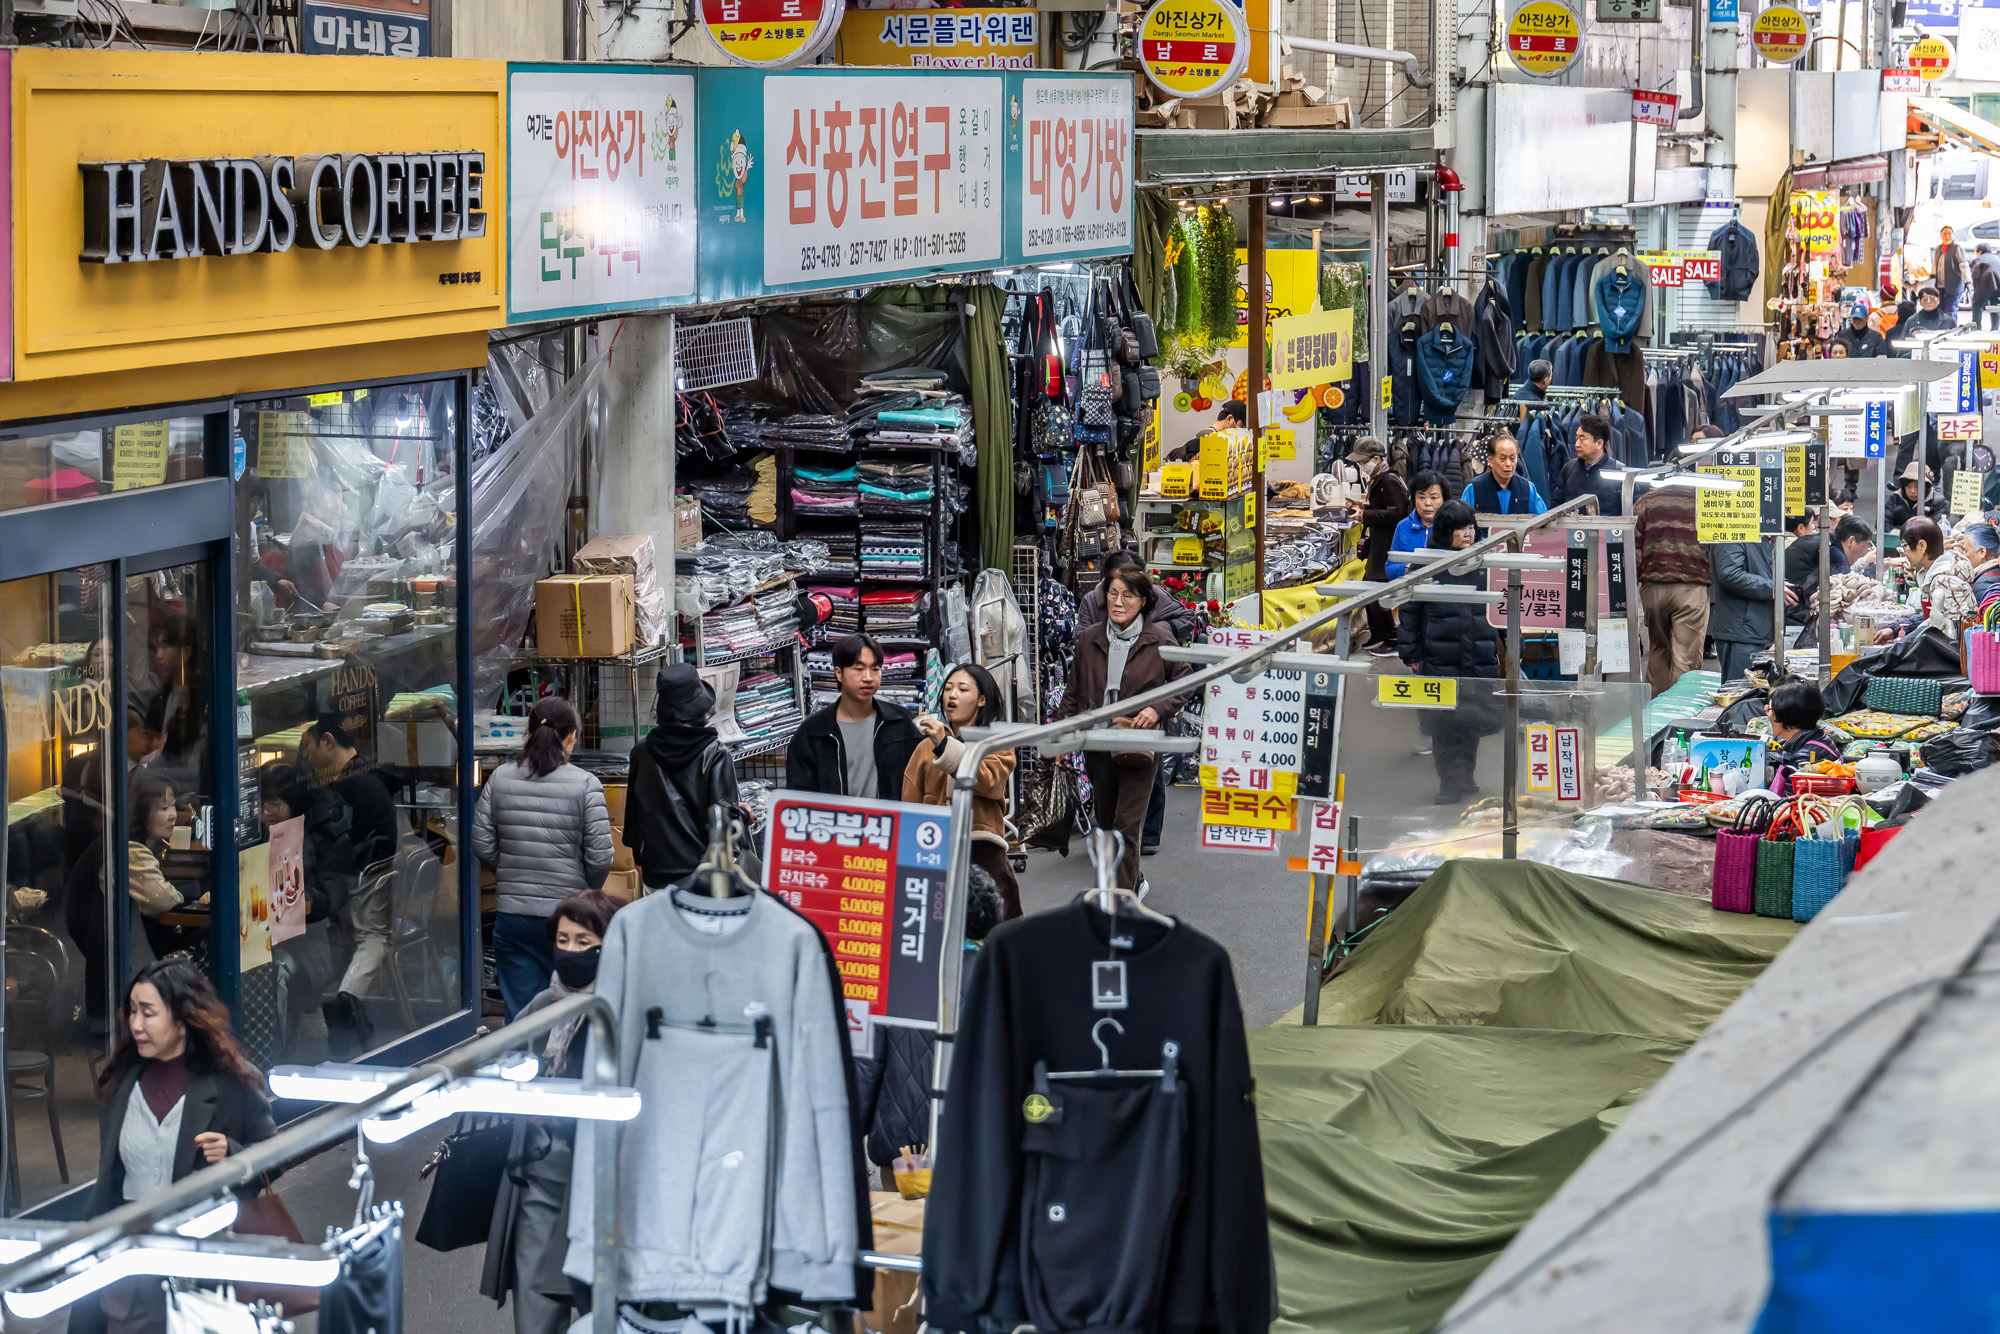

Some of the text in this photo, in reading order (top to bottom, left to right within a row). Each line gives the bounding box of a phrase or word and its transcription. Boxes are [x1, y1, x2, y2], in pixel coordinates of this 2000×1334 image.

[1155, 11, 1223, 30] 아진상가
[1519, 13, 1570, 28] 아진상가
[1761, 16, 1800, 27] 아진상가
[314, 15, 420, 57] 마네킹
[764, 28, 805, 39] 소방통로
[912, 54, 1034, 67] Flower land
[1188, 68, 1220, 76] 소방통로
[527, 110, 645, 182] 여기는 아진상가
[787, 101, 951, 229] 삼흥진열구
[1030, 117, 1127, 220] 대영가방
[80, 156, 295, 264] HANDS
[298, 150, 487, 250] COFFEE
[801, 244, 841, 271] 253-4793
[849, 239, 888, 266] 257-7427
[1652, 267, 1681, 285] SALE
[1685, 262, 1718, 278] SALE
[1941, 420, 1980, 439] 감주
[1736, 468, 1755, 477] 4.000
[1809, 452, 1817, 477] 먹거리
[1703, 490, 1755, 498] 납작만두 4.000
[1764, 476, 1772, 502] 먹거리
[1575, 531, 1584, 540] 3
[1571, 558, 1581, 591] 먹거리
[1611, 552, 1622, 584] 먹거리
[331, 663, 375, 696] HANDS
[1263, 669, 1302, 681] 4,000
[1316, 674, 1327, 688] 3
[338, 692, 367, 712] COFFEE
[1262, 688, 1301, 702] 5,000
[1227, 707, 1300, 724] 묵 5,000
[1306, 707, 1321, 749] 먹거리
[1260, 731, 1298, 745] 4,000
[1259, 752, 1297, 767] 4,000
[1531, 734, 1549, 781] 감주
[1561, 734, 1575, 795] 납작만두
[1205, 790, 1287, 819] 칼국수
[780, 805, 893, 851] 안동분식
[1209, 826, 1268, 843] 납작만두
[1312, 804, 1340, 870] 감주
[780, 848, 888, 873] 칼국수 5.000원
[916, 851, 941, 865] 1-21
[779, 868, 887, 894] 잔치국수 4.000원
[840, 897, 885, 916] 5.000원
[838, 918, 883, 937] 5.000원
[901, 877, 929, 962] 먹거리
[836, 940, 882, 958] 4.000원
